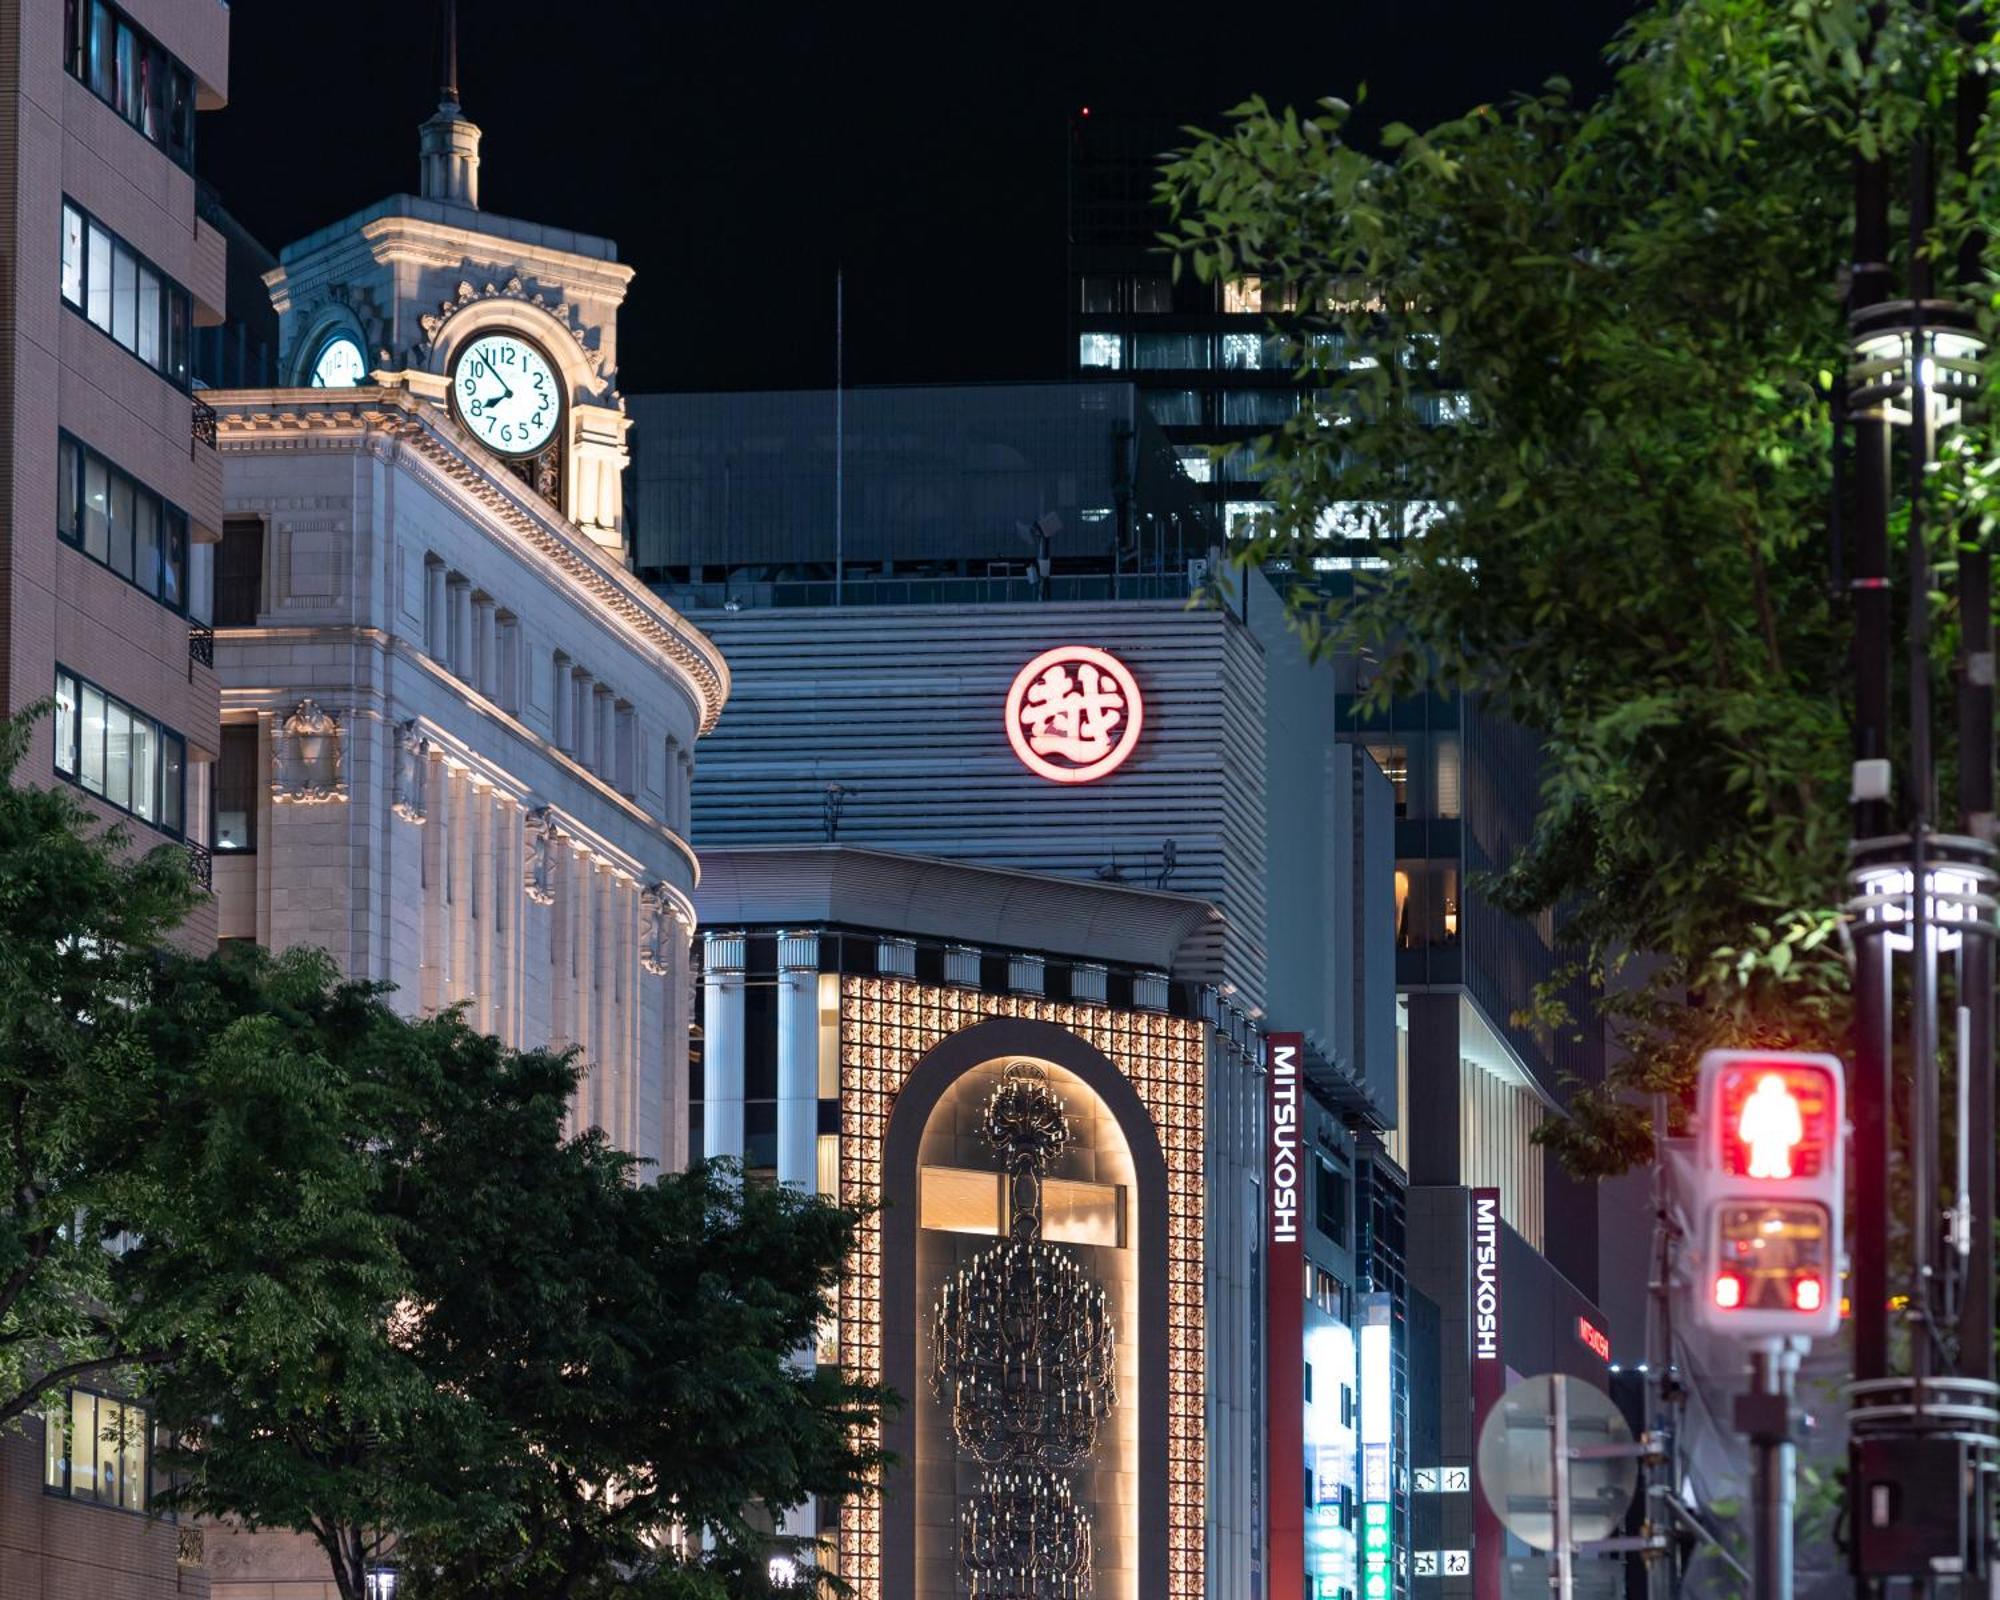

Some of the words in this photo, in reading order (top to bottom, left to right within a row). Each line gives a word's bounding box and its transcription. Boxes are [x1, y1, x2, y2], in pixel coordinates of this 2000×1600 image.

[485, 347, 496, 366] 11
[500, 346, 516, 365] 12
[522, 355, 527, 373] 1
[469, 359, 484, 379] 10
[464, 378, 477, 396] 9
[532, 371, 544, 390] 2
[470, 398, 482, 417] 8
[537, 392, 549, 411] 3
[485, 415, 497, 434] 7
[530, 411, 544, 429] 4
[500, 424, 512, 442] 6
[517, 422, 529, 440] 5
[1274, 1046, 1297, 1243] MITSUKOSHI
[1476, 1199, 1497, 1359] MITSUKOSHI
